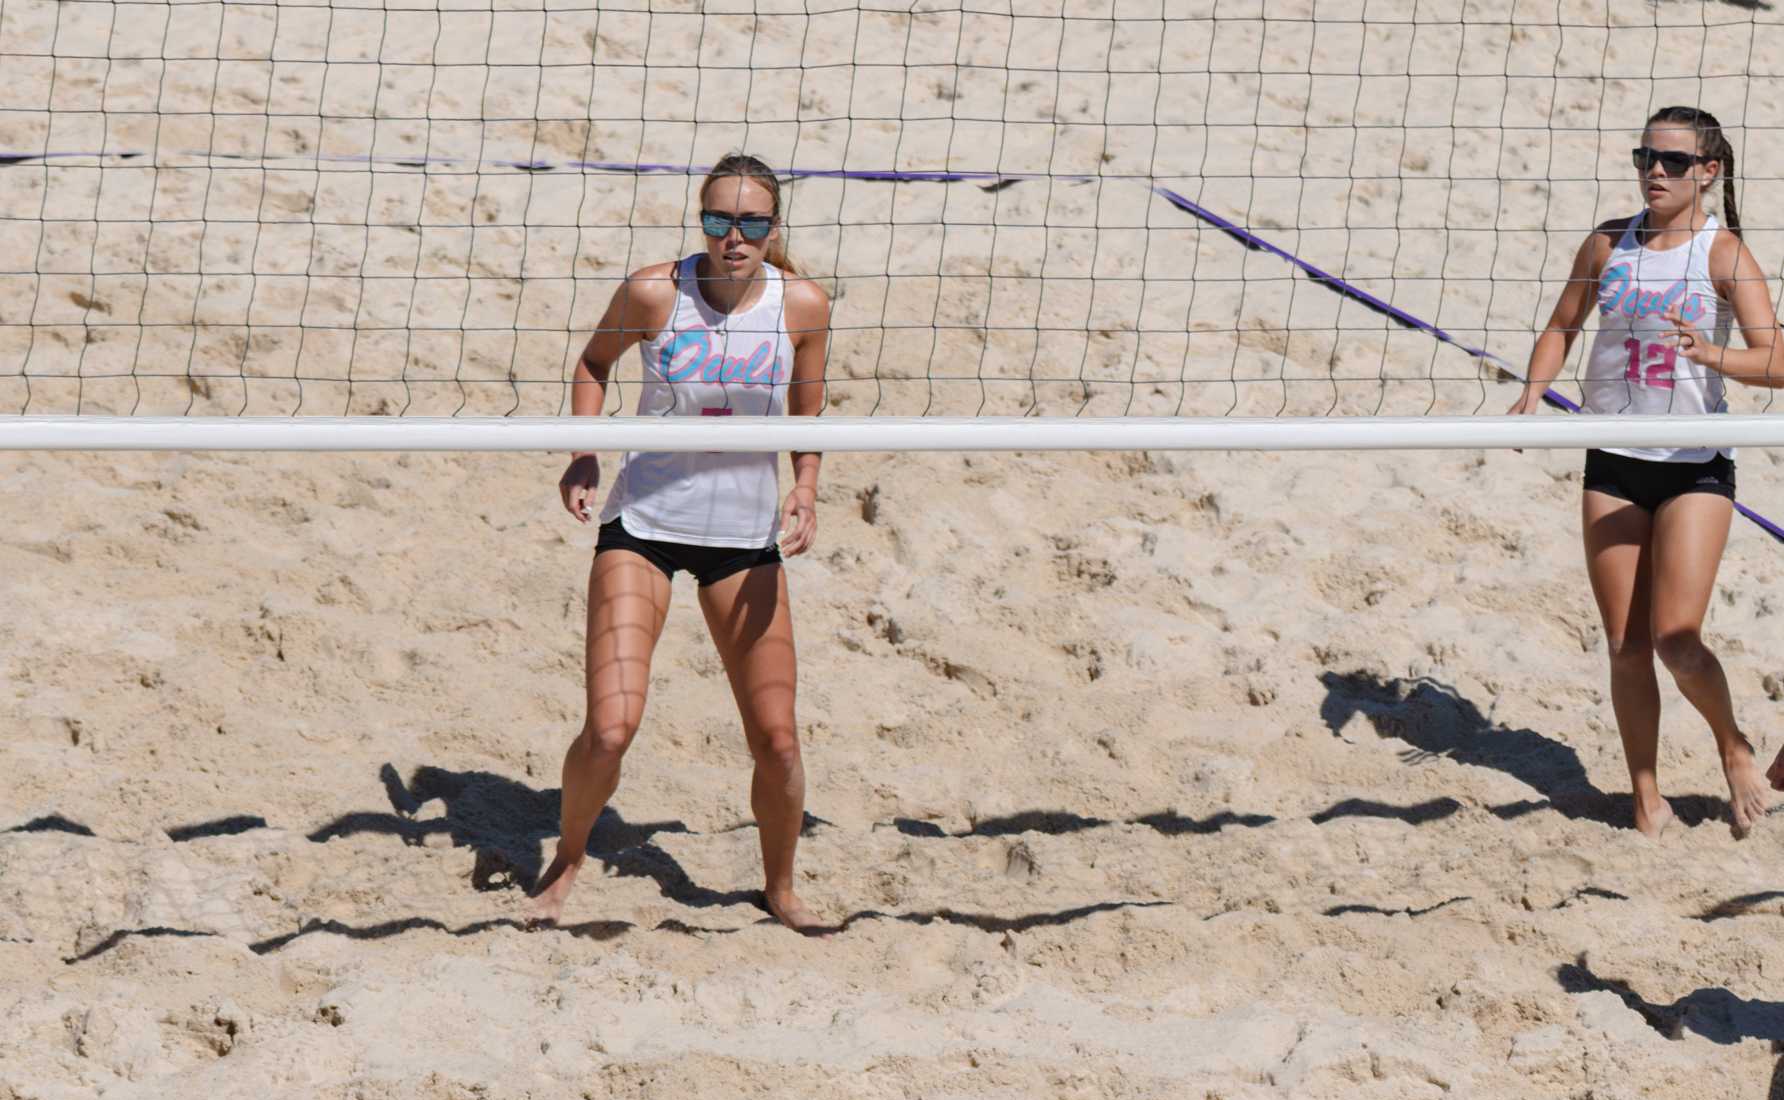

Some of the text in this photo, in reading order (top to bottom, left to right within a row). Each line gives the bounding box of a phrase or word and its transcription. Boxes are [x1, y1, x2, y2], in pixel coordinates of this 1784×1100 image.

[1599, 261, 1706, 322] Owls
[658, 324, 785, 390] Owls
[1624, 337, 1677, 390] 12
